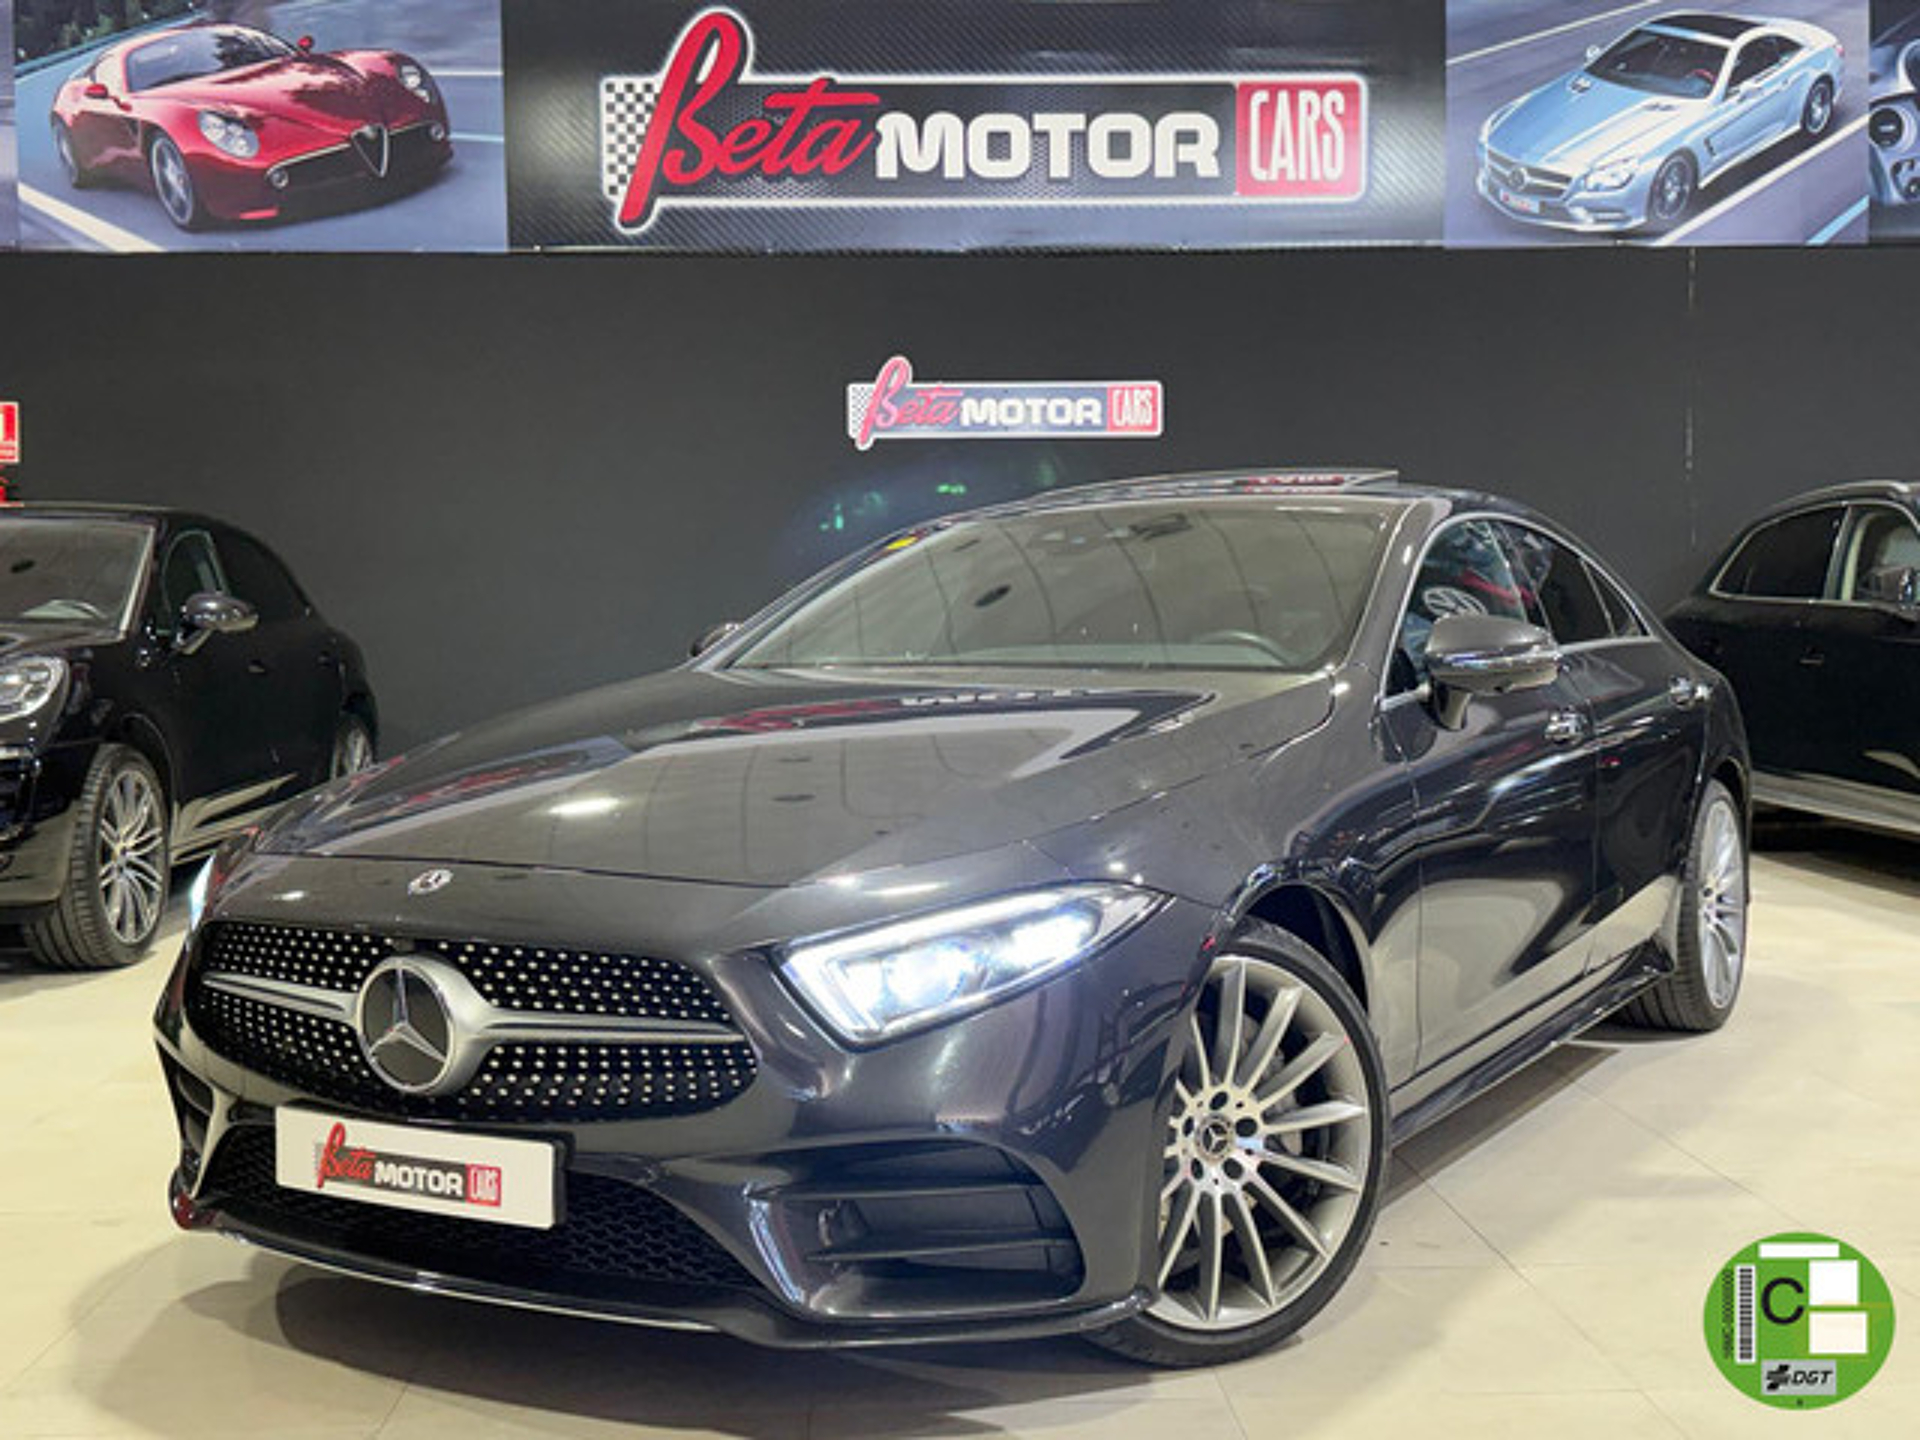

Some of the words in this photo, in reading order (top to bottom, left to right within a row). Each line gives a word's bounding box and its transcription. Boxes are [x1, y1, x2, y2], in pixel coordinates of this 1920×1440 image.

[876, 111, 1220, 180] MOTOR
[1248, 88, 1347, 186] CARS
[960, 397, 1102, 427] MOTOR
[1111, 388, 1154, 427] CARS
[374, 1161, 463, 1196] MOTOR
